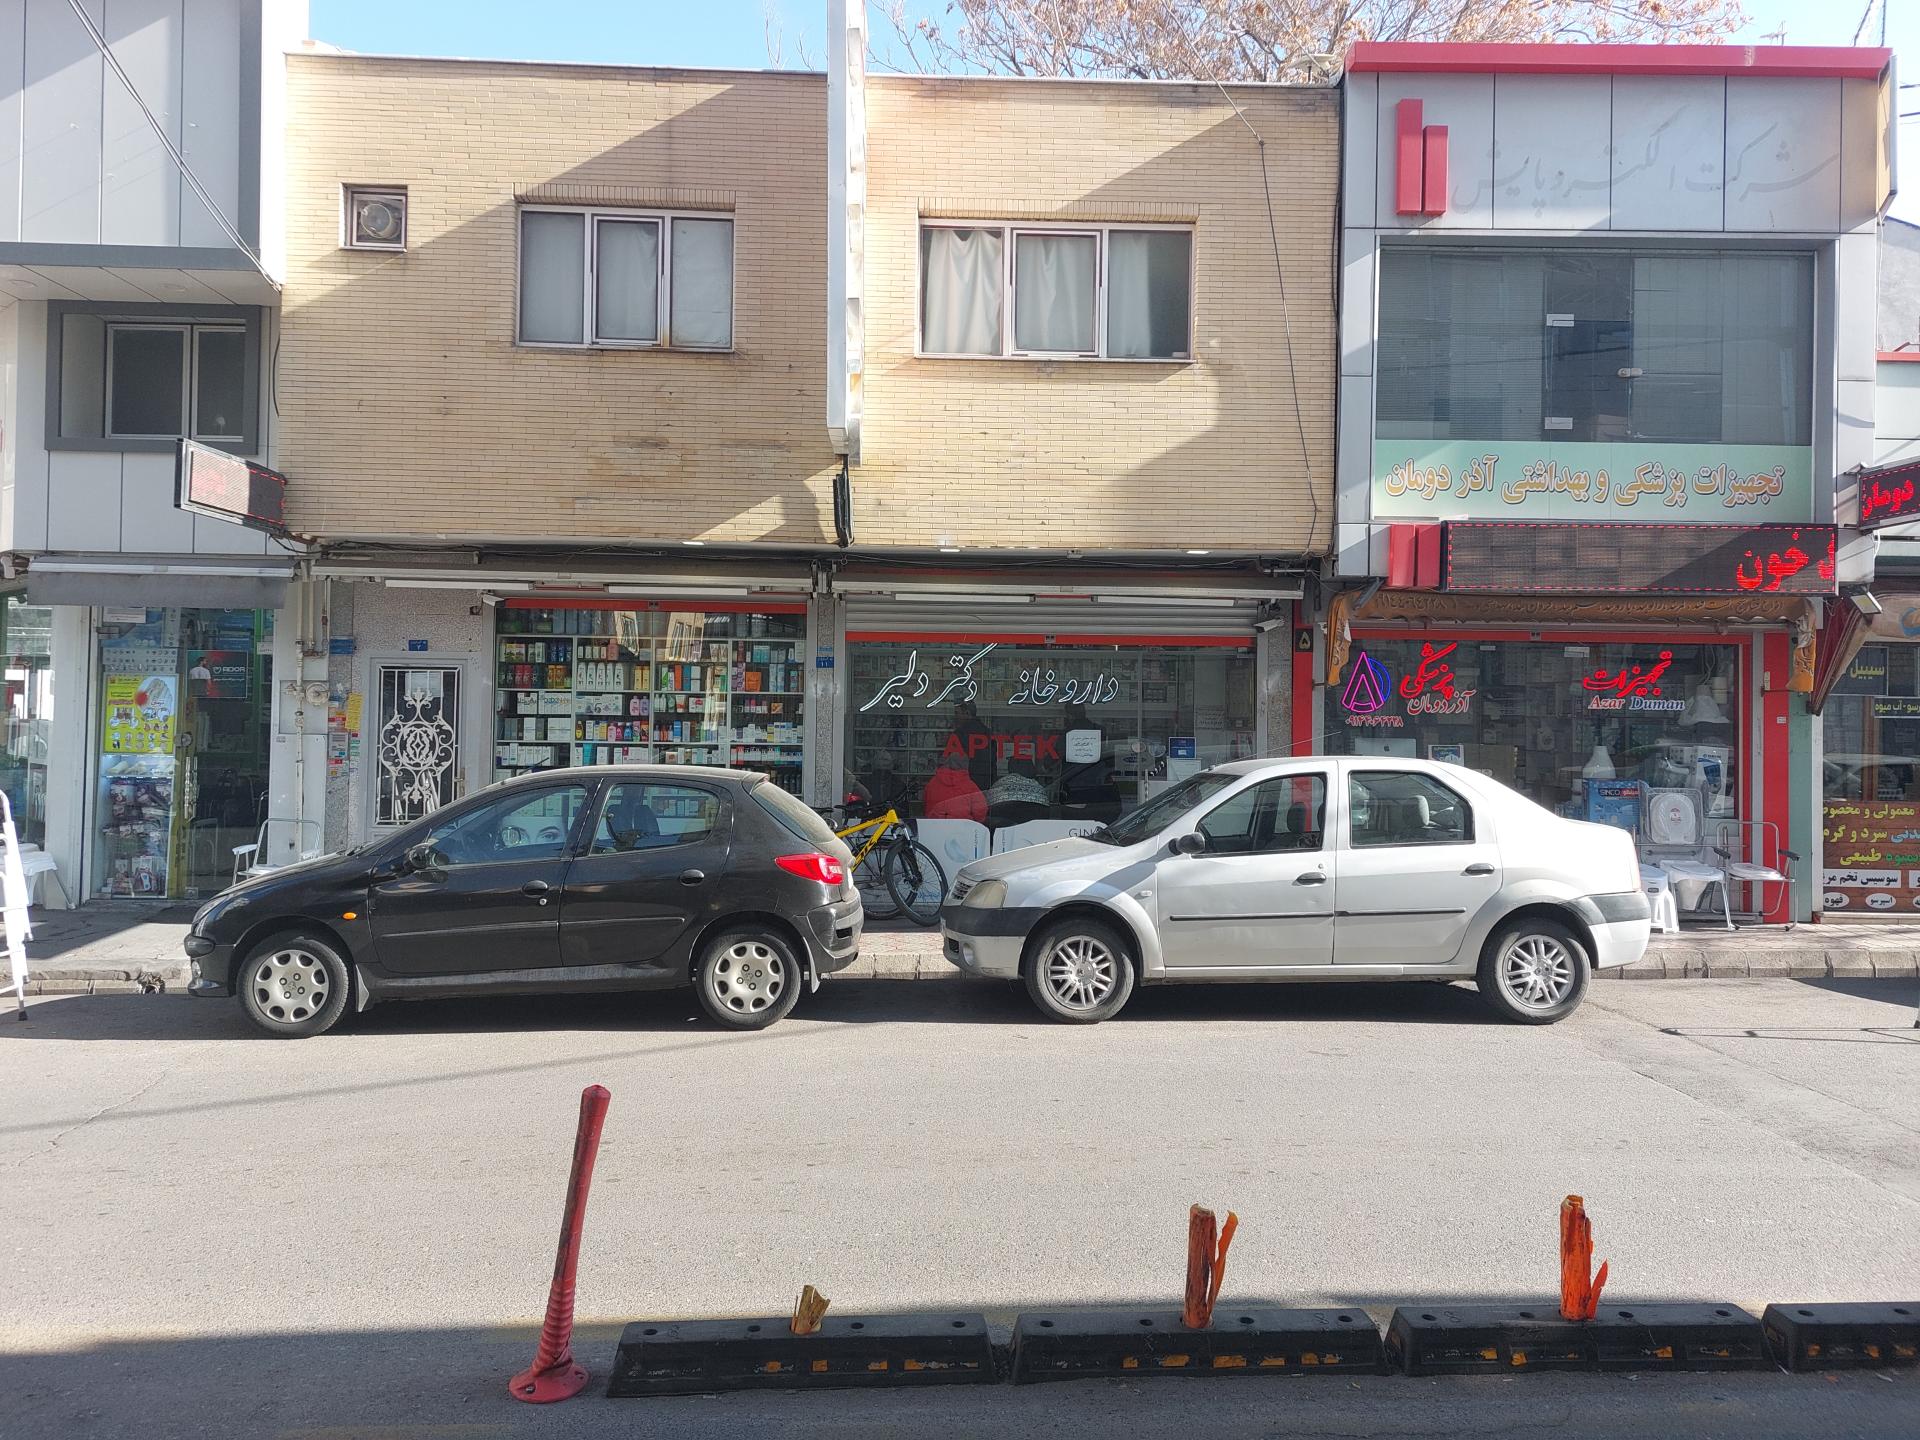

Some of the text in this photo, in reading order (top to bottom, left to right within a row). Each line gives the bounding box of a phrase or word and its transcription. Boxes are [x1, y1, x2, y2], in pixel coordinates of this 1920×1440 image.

[1385, 454, 1785, 508] تجهیزات پزشکی و بهداشتی آذر دومان
[1736, 531, 1809, 591] خون
[1299, 631, 1311, 650] ۵
[859, 642, 1119, 712] داروخانه دکتر دلیر
[1399, 641, 1458, 700] پزشکی
[1582, 650, 1673, 698] تجهیزات
[1588, 695, 1685, 711] Azar Duman
[942, 733, 1061, 760] APTEK
[1863, 808, 1870, 819] و
[1872, 803, 1916, 819] معمولی
[1850, 828, 1857, 843] و
[1860, 827, 1888, 843] سرد
[1839, 847, 1882, 866] طبیعی
[1839, 871, 1859, 885] تخم
[1860, 875, 1899, 887] سوسیس
[1824, 894, 1844, 907] قهوه
